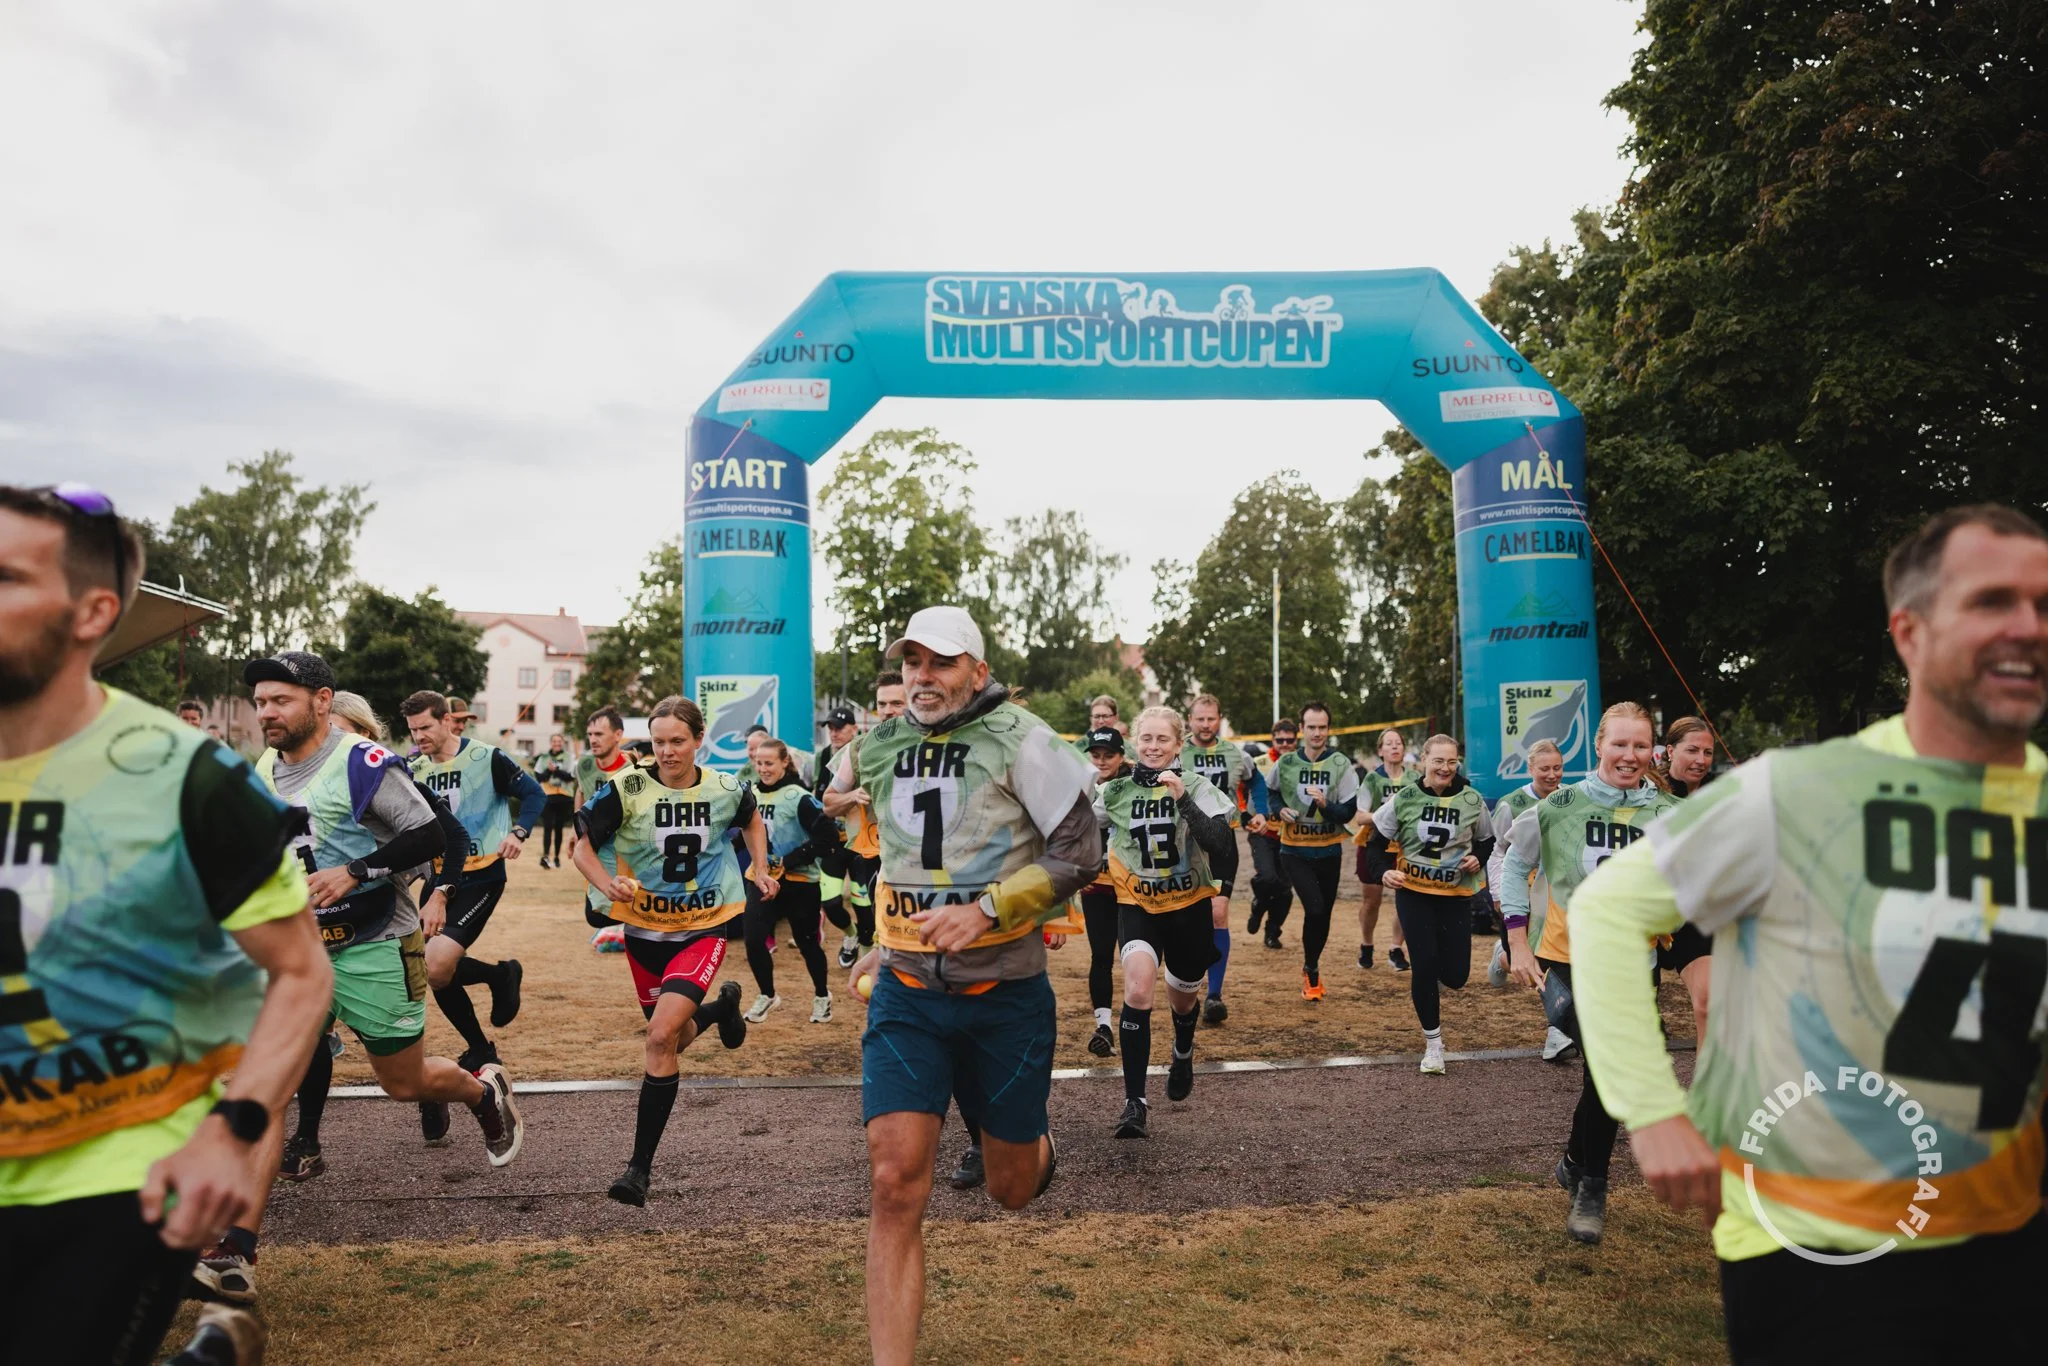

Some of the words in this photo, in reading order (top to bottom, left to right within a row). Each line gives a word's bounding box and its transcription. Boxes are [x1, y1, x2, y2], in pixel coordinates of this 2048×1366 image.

[932, 280, 1116, 318] SVENSKA
[932, 316, 1325, 362] MULTISPORTCUPEN
[747, 344, 855, 368] SUUNTO
[1412, 355, 1524, 378] SUUNTO
[1453, 391, 1538, 408] MERRELL
[690, 457, 787, 492] START
[1501, 451, 1573, 492] MÅL
[690, 527, 788, 558] CAMELBAK
[1484, 530, 1586, 563] CAMELBAK
[690, 617, 786, 636] montrail
[1488, 620, 1589, 643] montrail
[700, 680, 738, 693] Skinz
[1505, 685, 1552, 699] Skinz
[1505, 699, 1518, 736] Seal
[1299, 767, 1330, 786] ÖAR
[655, 798, 711, 828] ÖAR
[1130, 795, 1175, 819] ÖAR
[1421, 802, 1460, 826] ÖAR
[913, 787, 943, 870] 1
[1293, 823, 1336, 836] JOKAB
[1129, 822, 1181, 869] 13
[1419, 826, 1450, 860] 2
[662, 833, 702, 883] 8
[1403, 863, 1456, 883] JOKAB
[1133, 874, 1193, 897] JOKAB
[640, 889, 716, 914] JOKAB
[699, 962, 716, 985] TEAM
[1883, 931, 2048, 1133] 4
